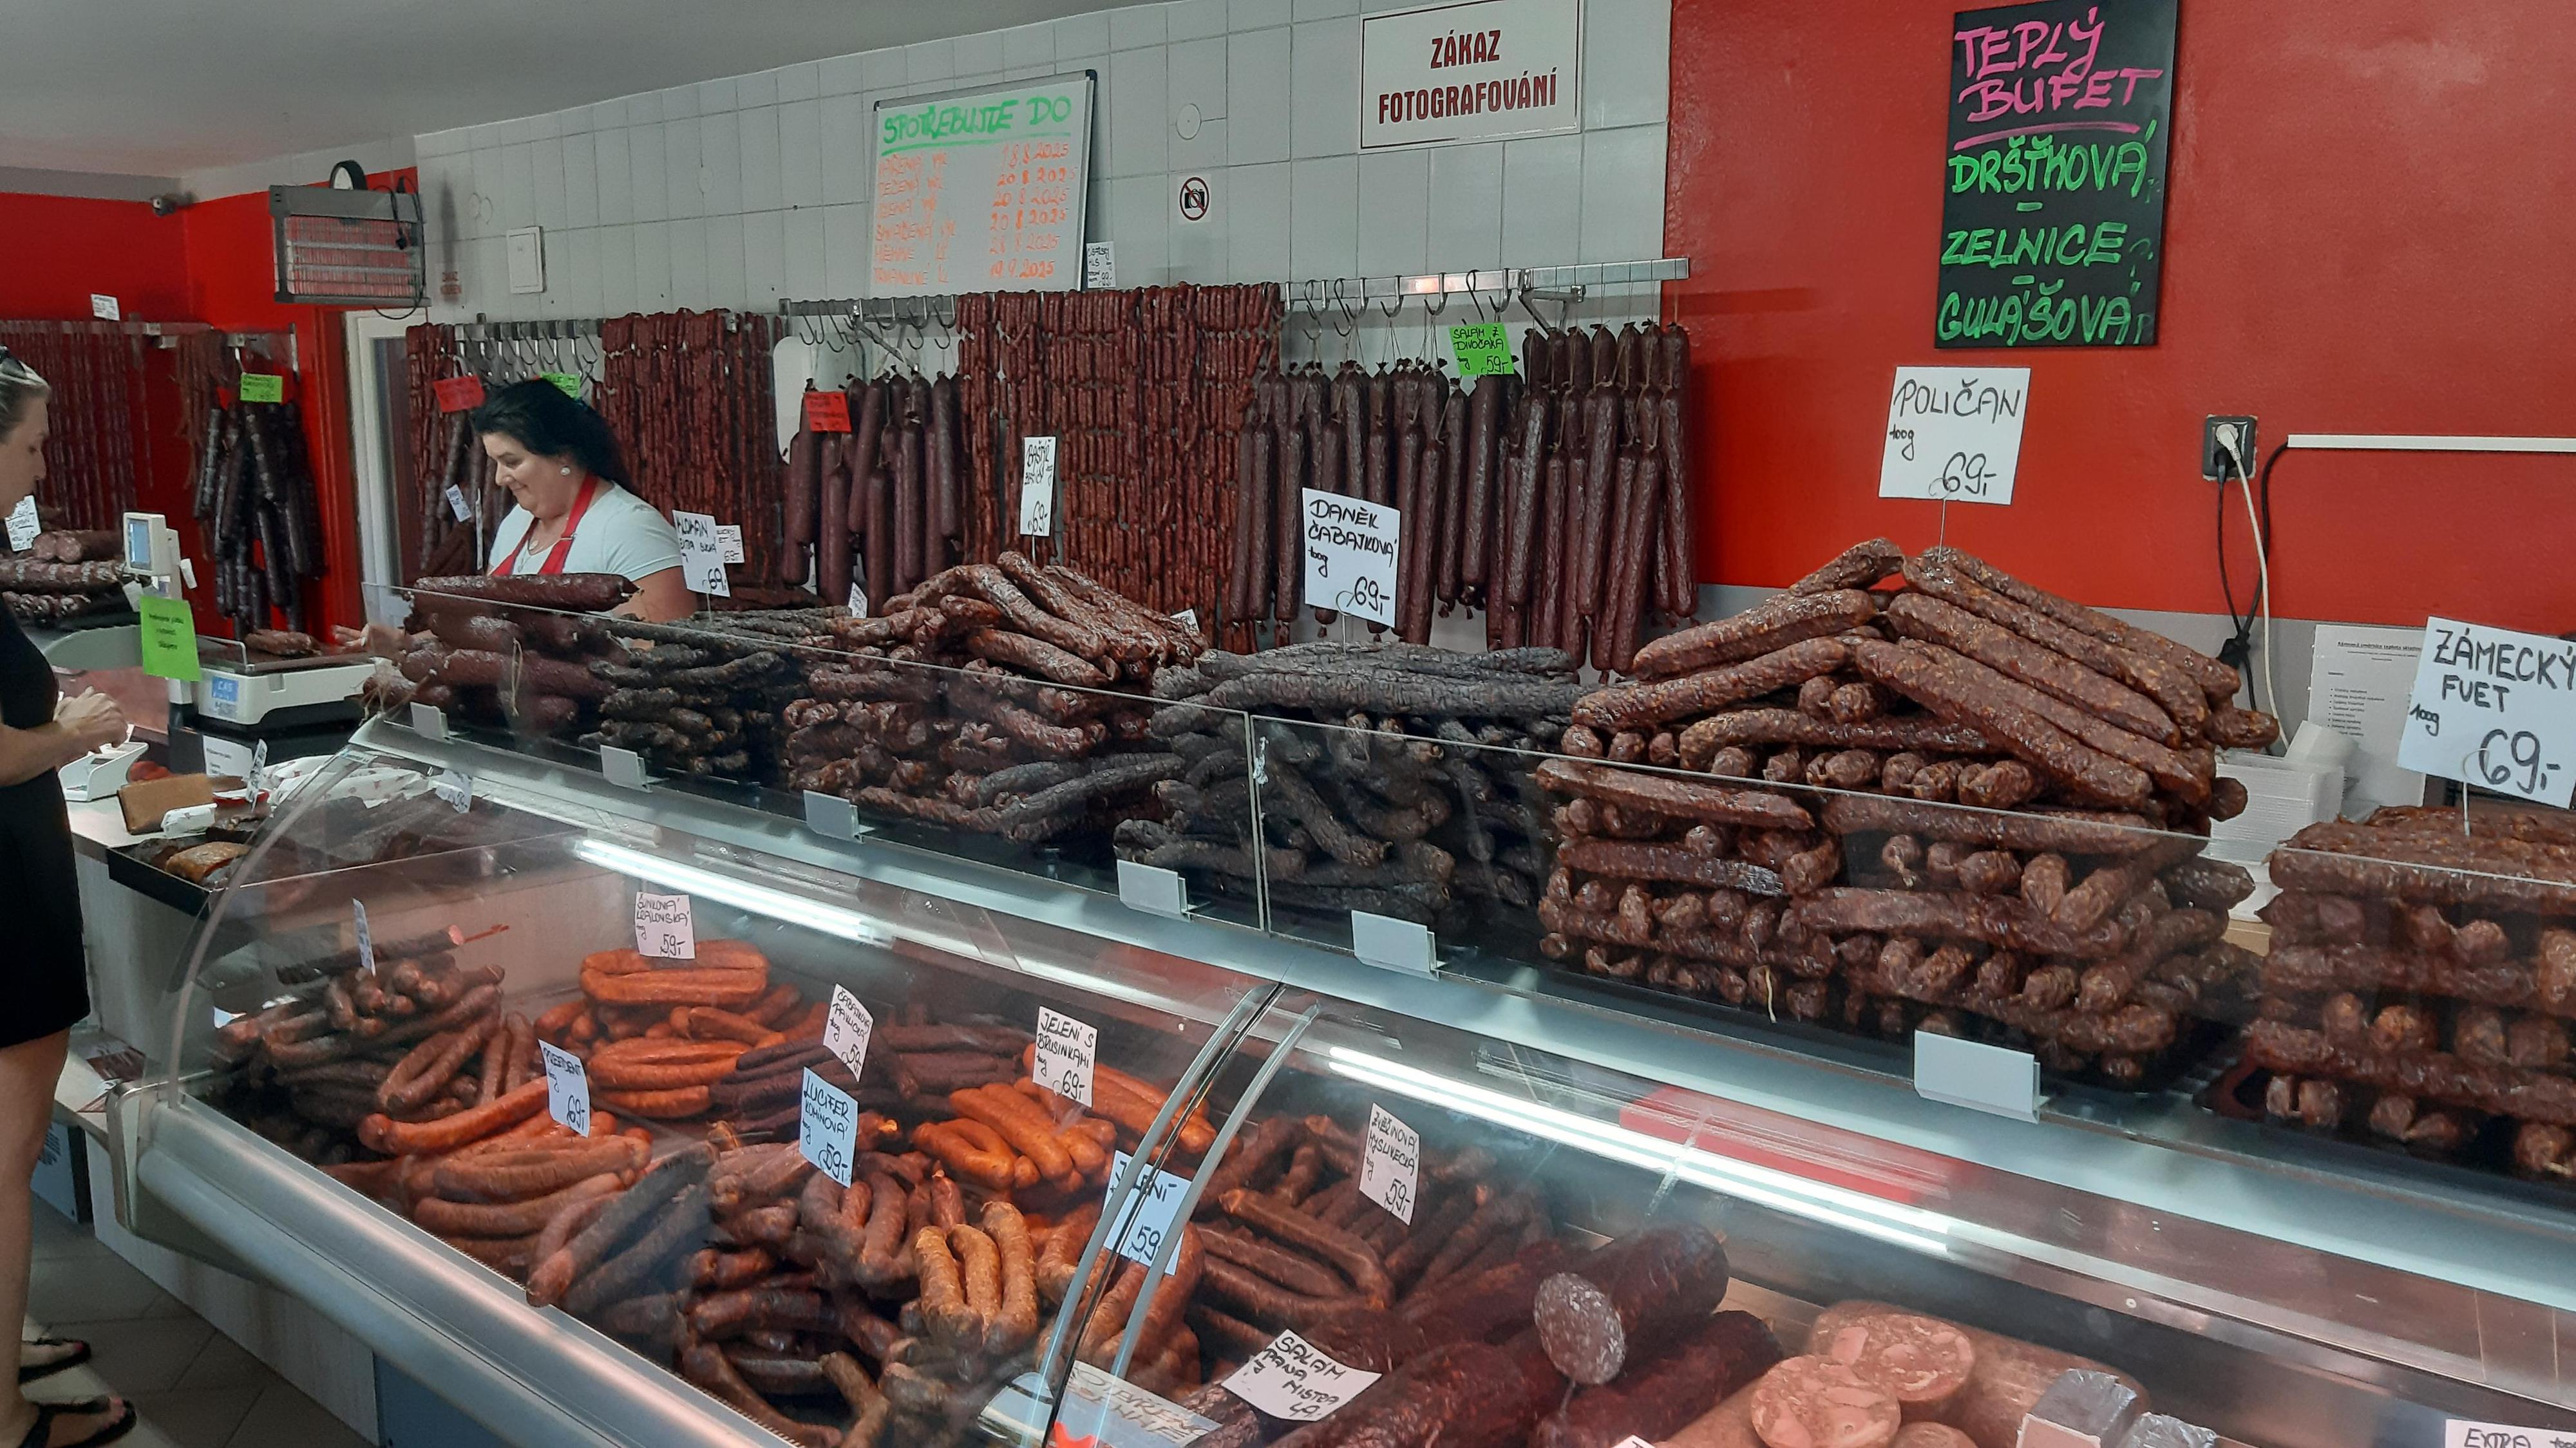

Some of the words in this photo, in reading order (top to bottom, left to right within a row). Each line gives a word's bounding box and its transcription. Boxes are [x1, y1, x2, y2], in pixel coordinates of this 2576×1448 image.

[1430, 30, 1501, 68] ZÁKAZ
[1954, 6, 2105, 84] TEPLÝ
[1026, 96, 1072, 125] DO
[1379, 67, 1557, 124] FOTOGRAFOVÁNÍ
[1958, 67, 2163, 122] BUFET
[1948, 119, 2157, 198] DRŠŤKOVÁ
[1941, 221, 2128, 268] ZELNICE
[1893, 379, 2021, 424] POLIČAN
[1942, 452, 1997, 496] 69,-
[1309, 499, 1379, 529] DANĚK
[1308, 520, 1397, 567] ČABAJKOVÁ
[1354, 576, 1390, 617] 69,-
[2434, 628, 2576, 691] ZÁMECKÝ
[2441, 674, 2510, 712] FUET
[2479, 729, 2561, 794] 69,-
[1037, 1033, 1090, 1069] BRUSINKAMI
[1041, 1012, 1083, 1042] JELENÍ
[1084, 1033, 1094, 1048] S
[804, 1075, 850, 1123] LUCIFER
[1262, 1348, 1307, 1382] PANA
[1275, 1337, 1346, 1380] SALÁM
